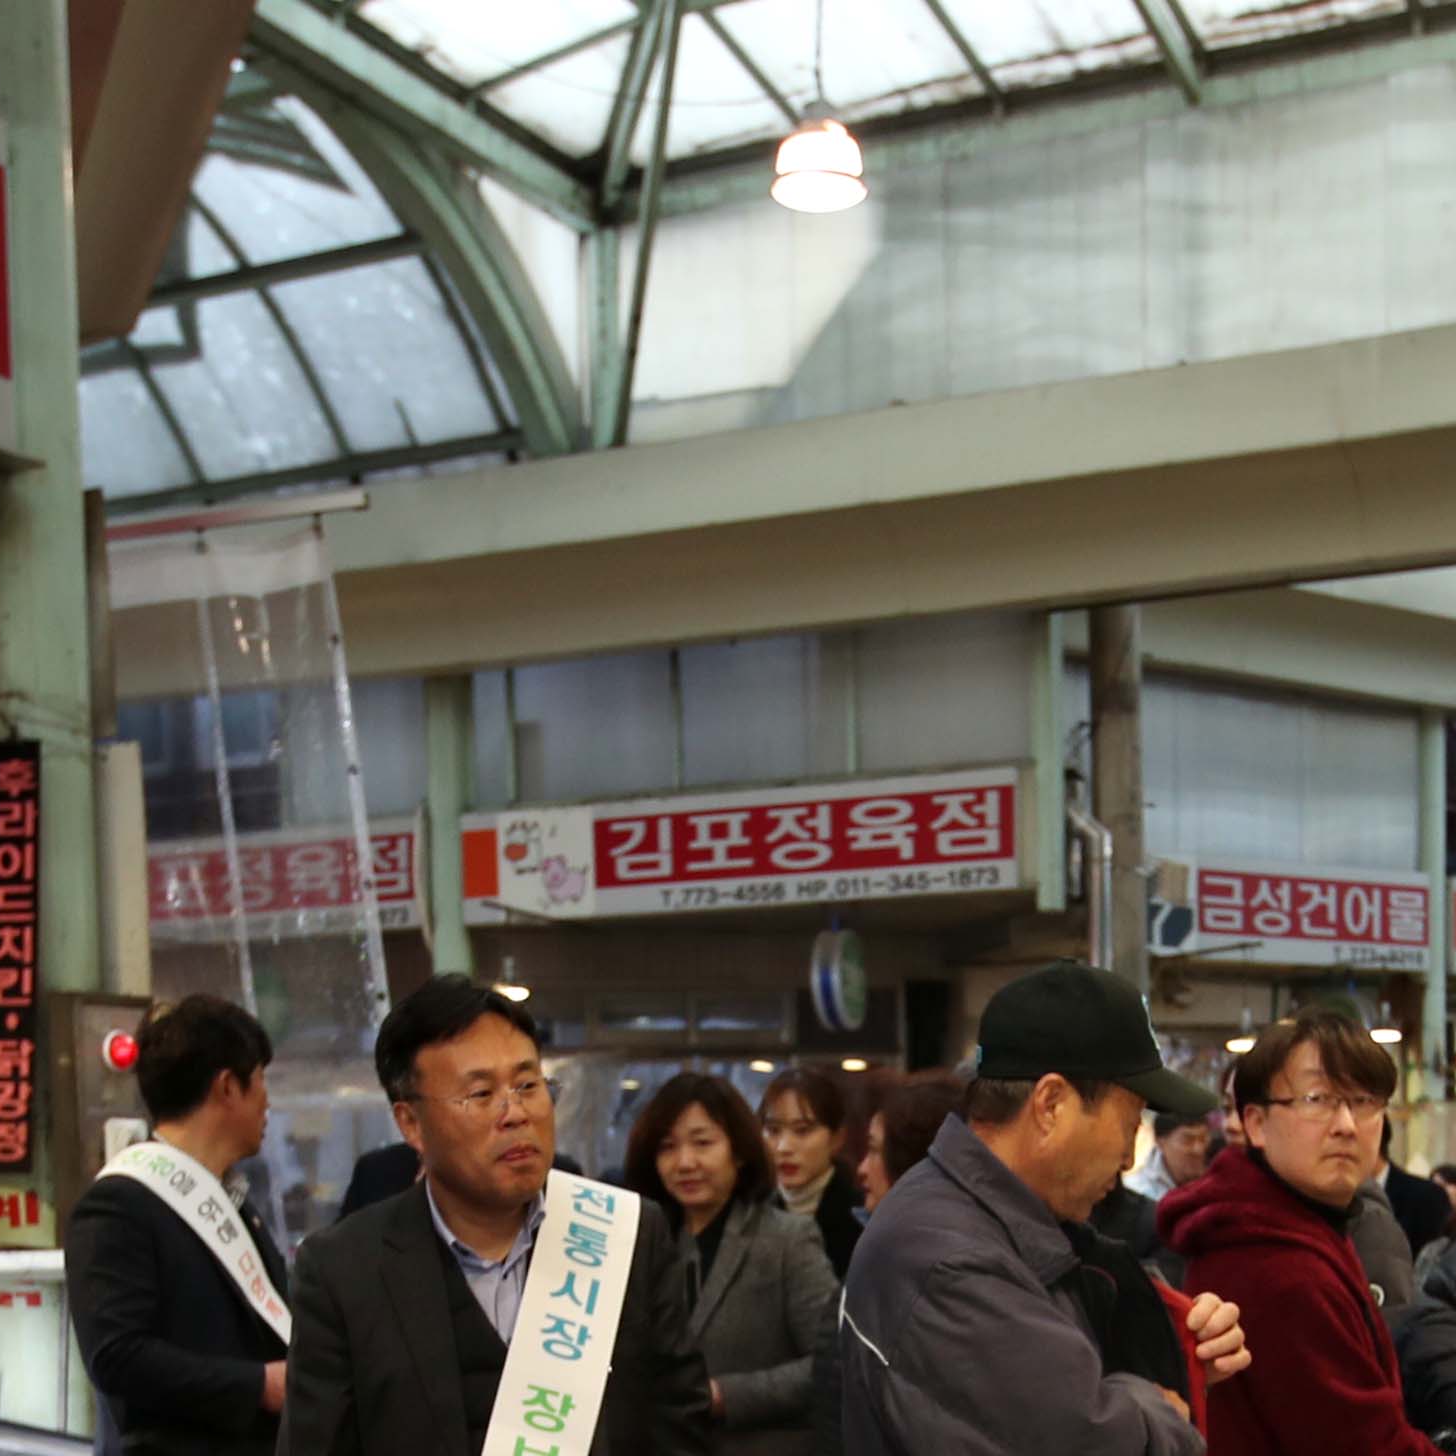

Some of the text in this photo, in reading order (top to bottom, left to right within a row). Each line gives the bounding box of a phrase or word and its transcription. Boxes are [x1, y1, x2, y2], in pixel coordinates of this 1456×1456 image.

[606, 790, 1001, 881] 김포정육점
[1203, 874, 1425, 941] 금성건어물
[540, 1180, 617, 1361] 전통시장
